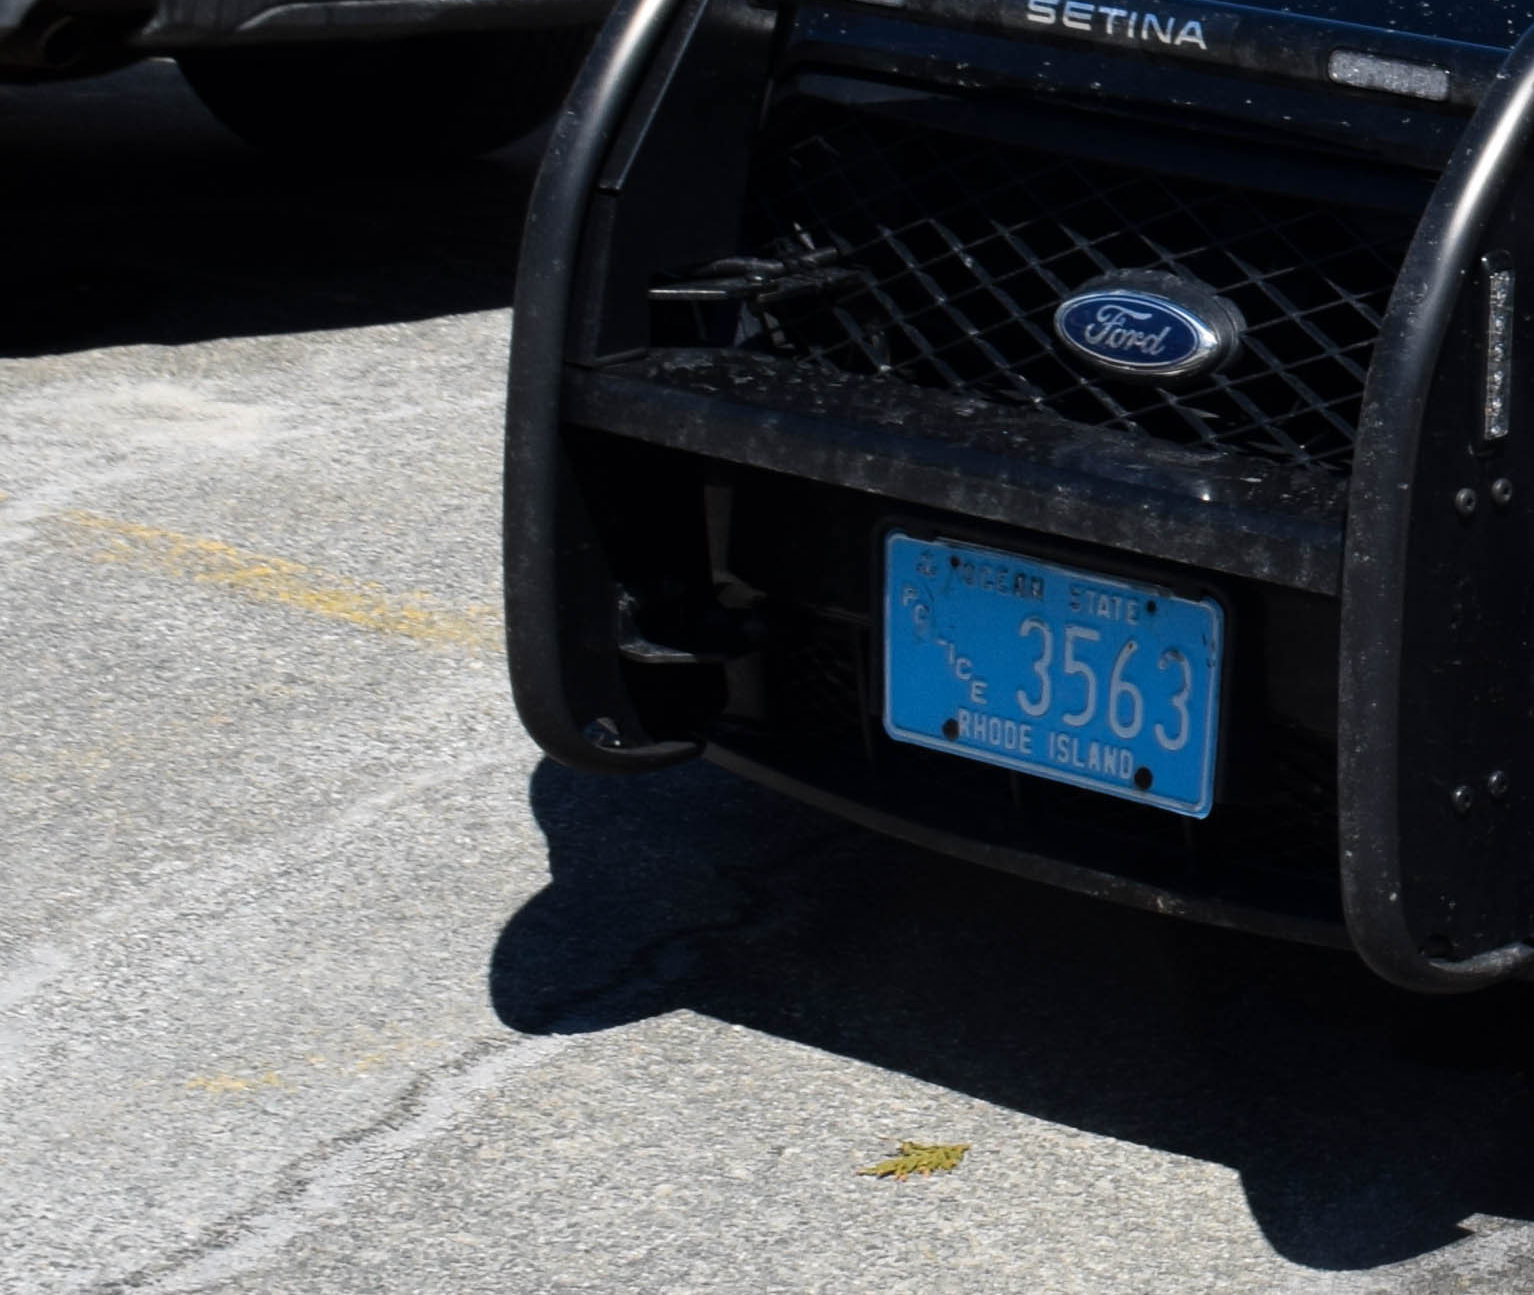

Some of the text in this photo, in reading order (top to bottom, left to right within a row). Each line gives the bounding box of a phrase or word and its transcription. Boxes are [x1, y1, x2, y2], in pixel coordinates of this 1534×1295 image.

[1084, 305, 1173, 356] Ford
[1068, 585, 1140, 627] STATE
[1016, 616, 1193, 752] 3563
[956, 708, 1136, 781] RHODE ISLAND
